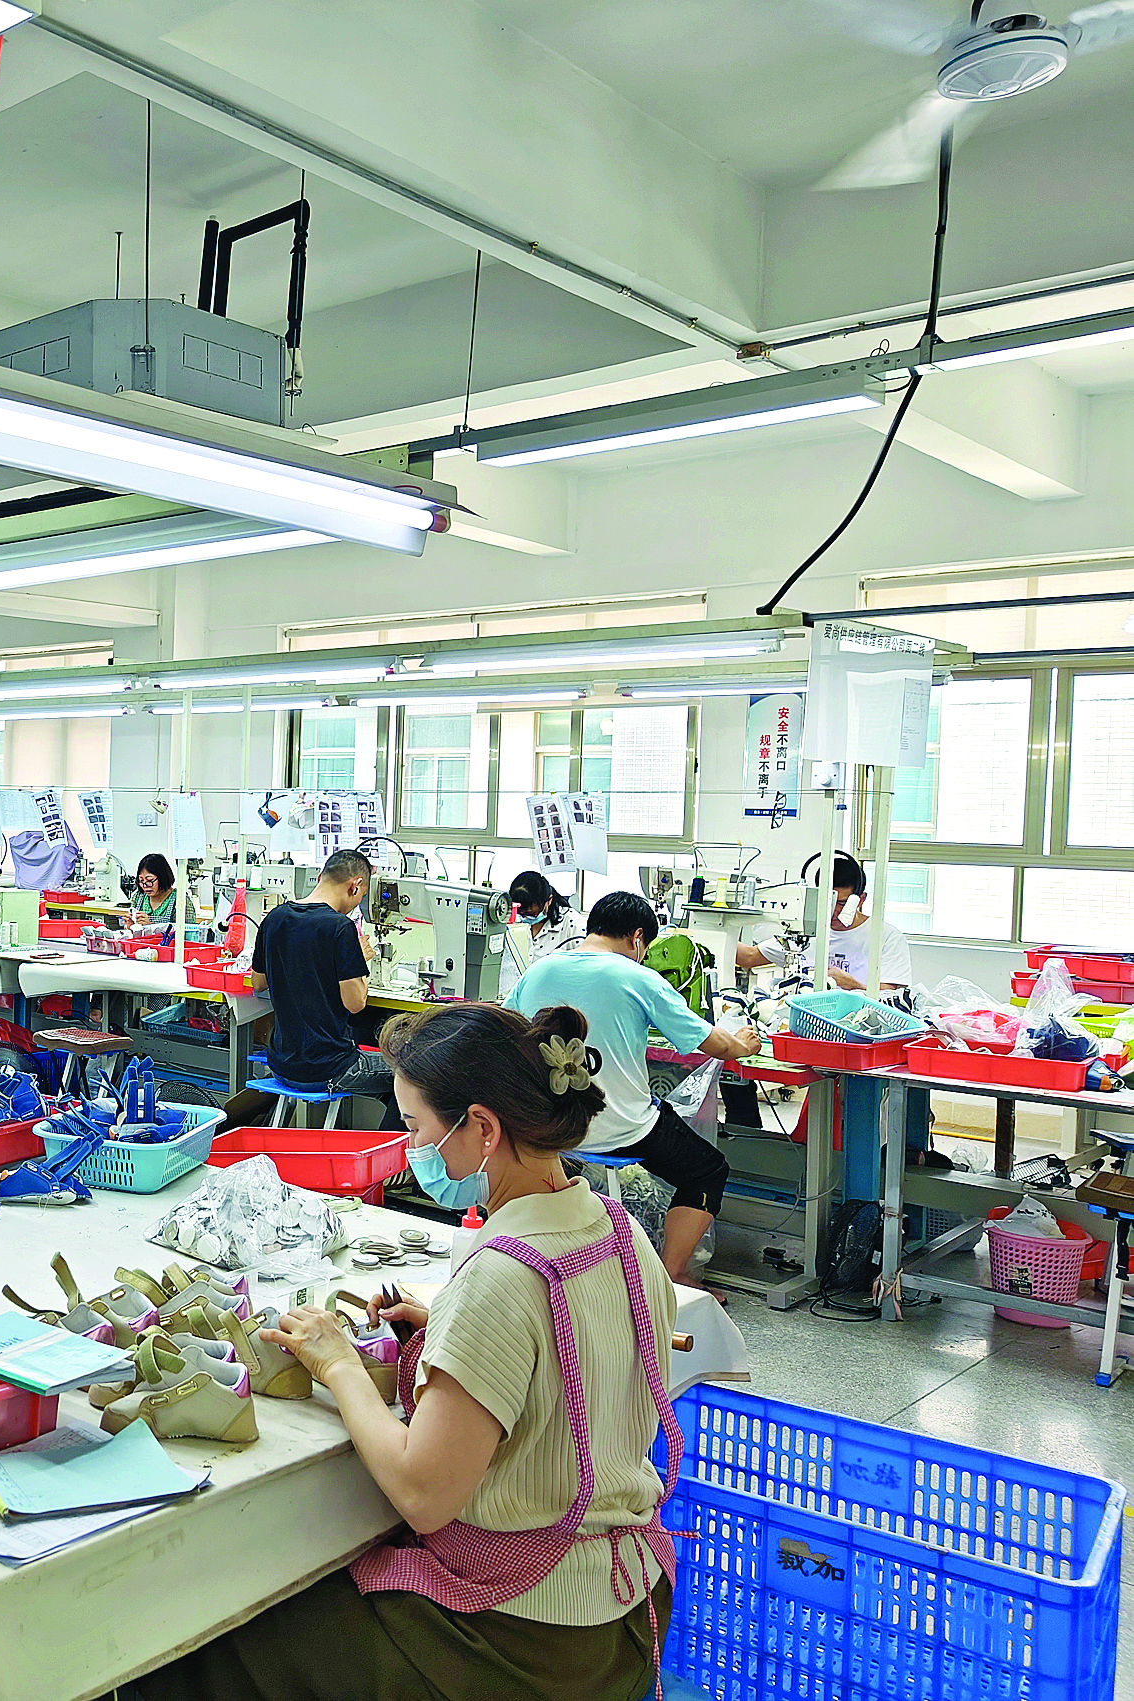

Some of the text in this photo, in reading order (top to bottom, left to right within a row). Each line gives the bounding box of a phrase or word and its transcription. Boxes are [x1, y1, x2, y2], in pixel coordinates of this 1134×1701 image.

[776, 707, 790, 771] 安全不离口
[267, 878, 285, 886] TTY
[435, 897, 461, 908] TTY
[759, 900, 788, 910] TTY
